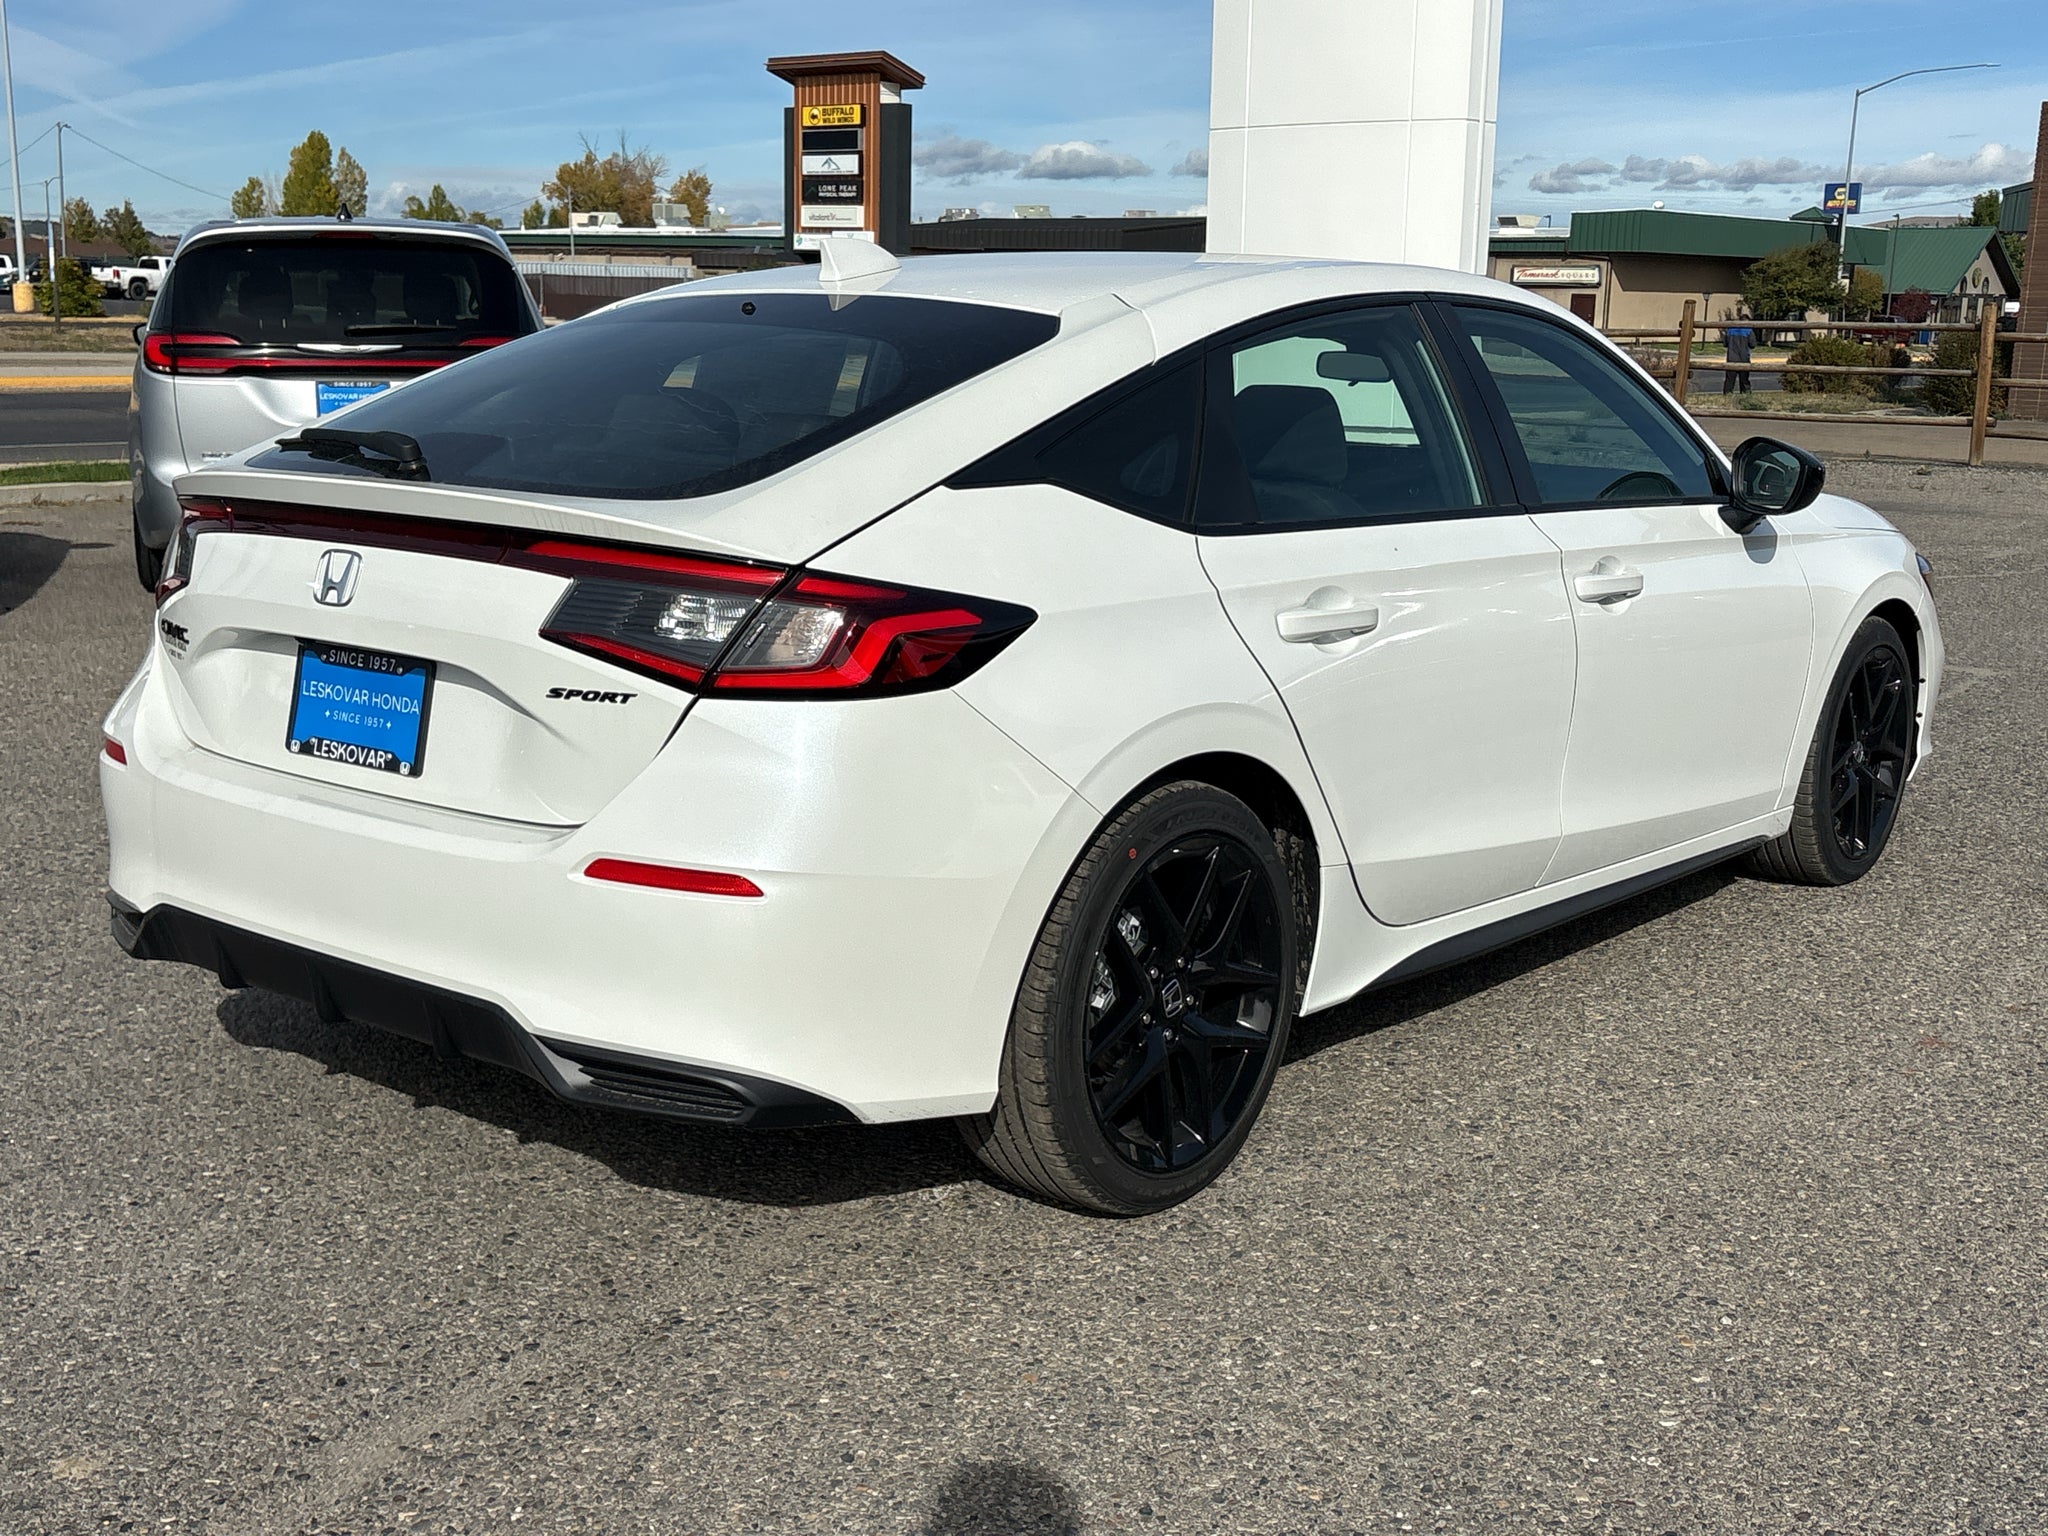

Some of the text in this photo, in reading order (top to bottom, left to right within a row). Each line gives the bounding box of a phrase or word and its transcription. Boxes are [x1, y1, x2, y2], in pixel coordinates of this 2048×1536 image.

[822, 107, 855, 117] BUFFALO
[818, 184, 837, 192] LONE
[1516, 267, 1561, 281] Tamarack
[330, 649, 396, 672] SINCE 1957
[302, 680, 420, 715] LESKOVAR HONDA
[545, 687, 638, 704] SPORT
[332, 710, 384, 729] SINCE 1957
[313, 738, 386, 769] LESKOVAR
